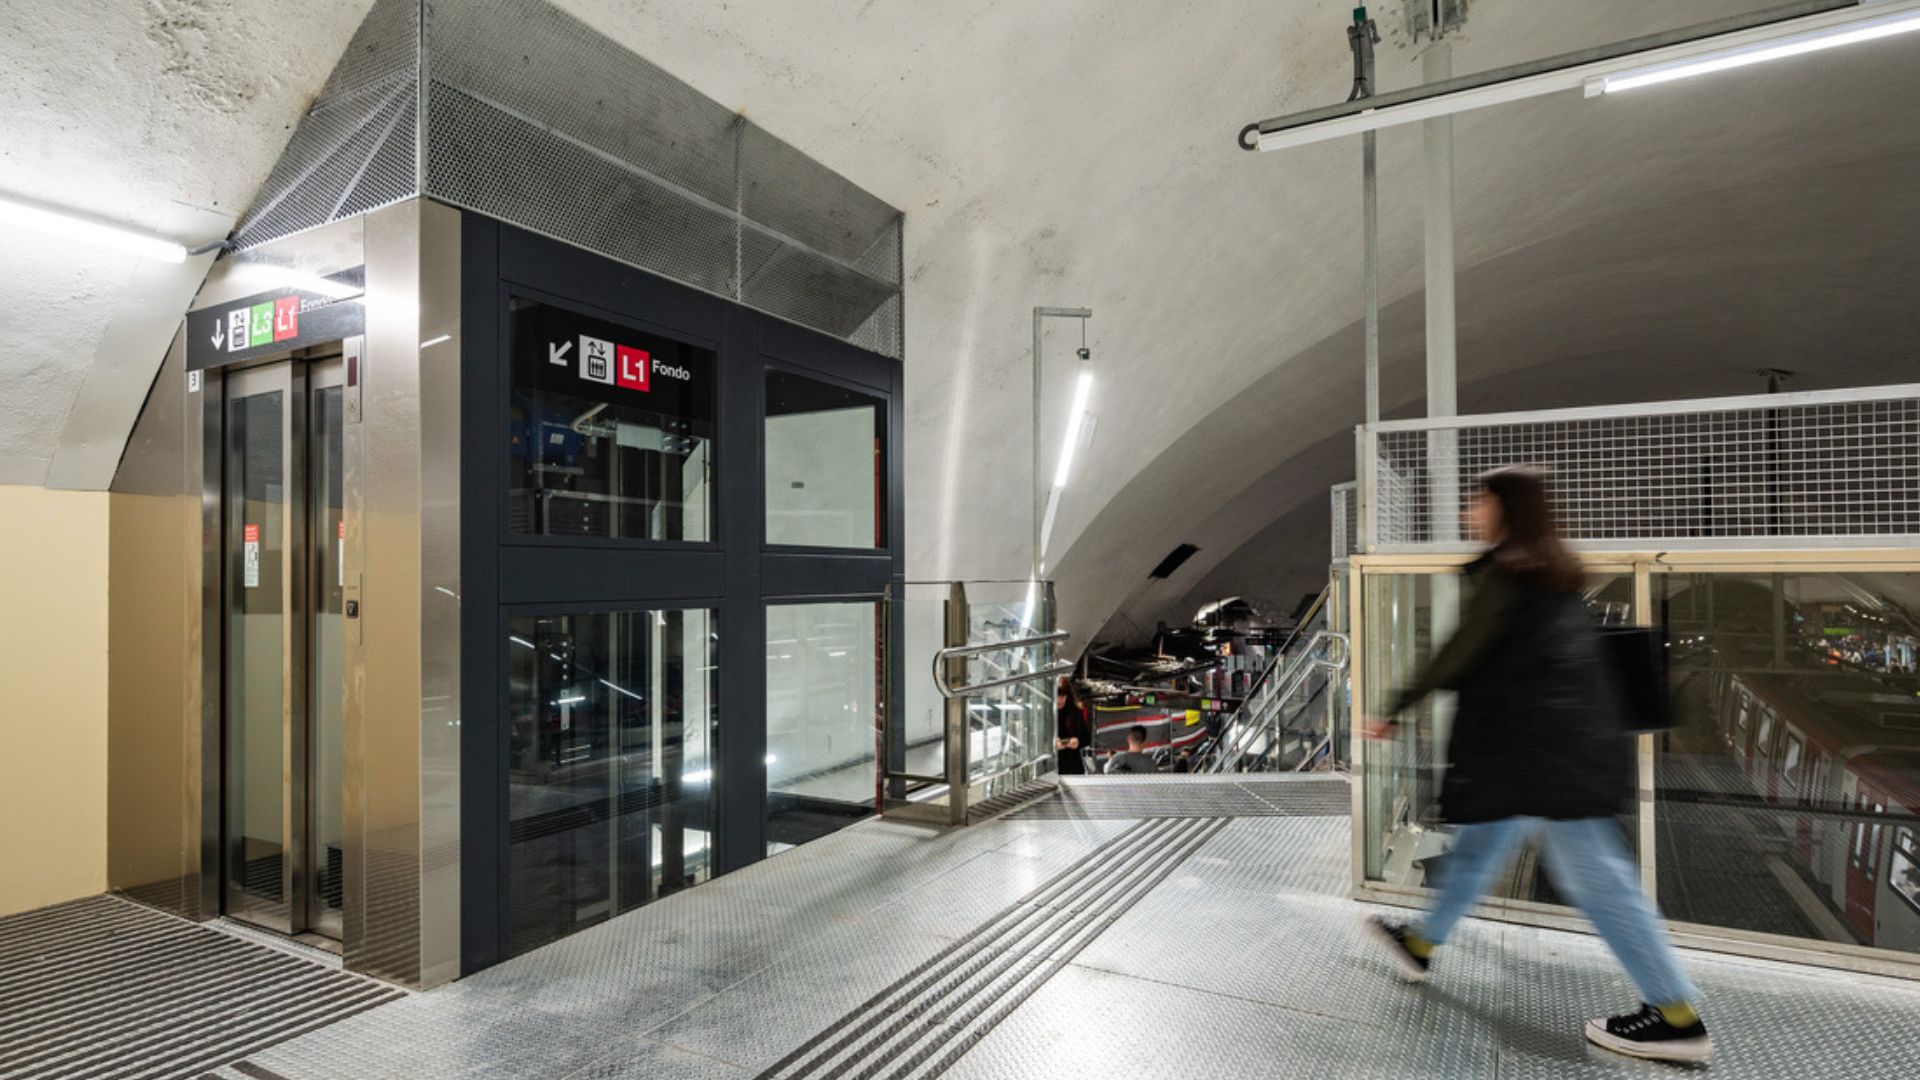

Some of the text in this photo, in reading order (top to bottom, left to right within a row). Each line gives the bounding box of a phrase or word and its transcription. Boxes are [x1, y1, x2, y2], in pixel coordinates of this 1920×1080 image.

[253, 311, 272, 336] L3
[277, 304, 296, 332] L1
[622, 354, 691, 383] L1 Fondo
